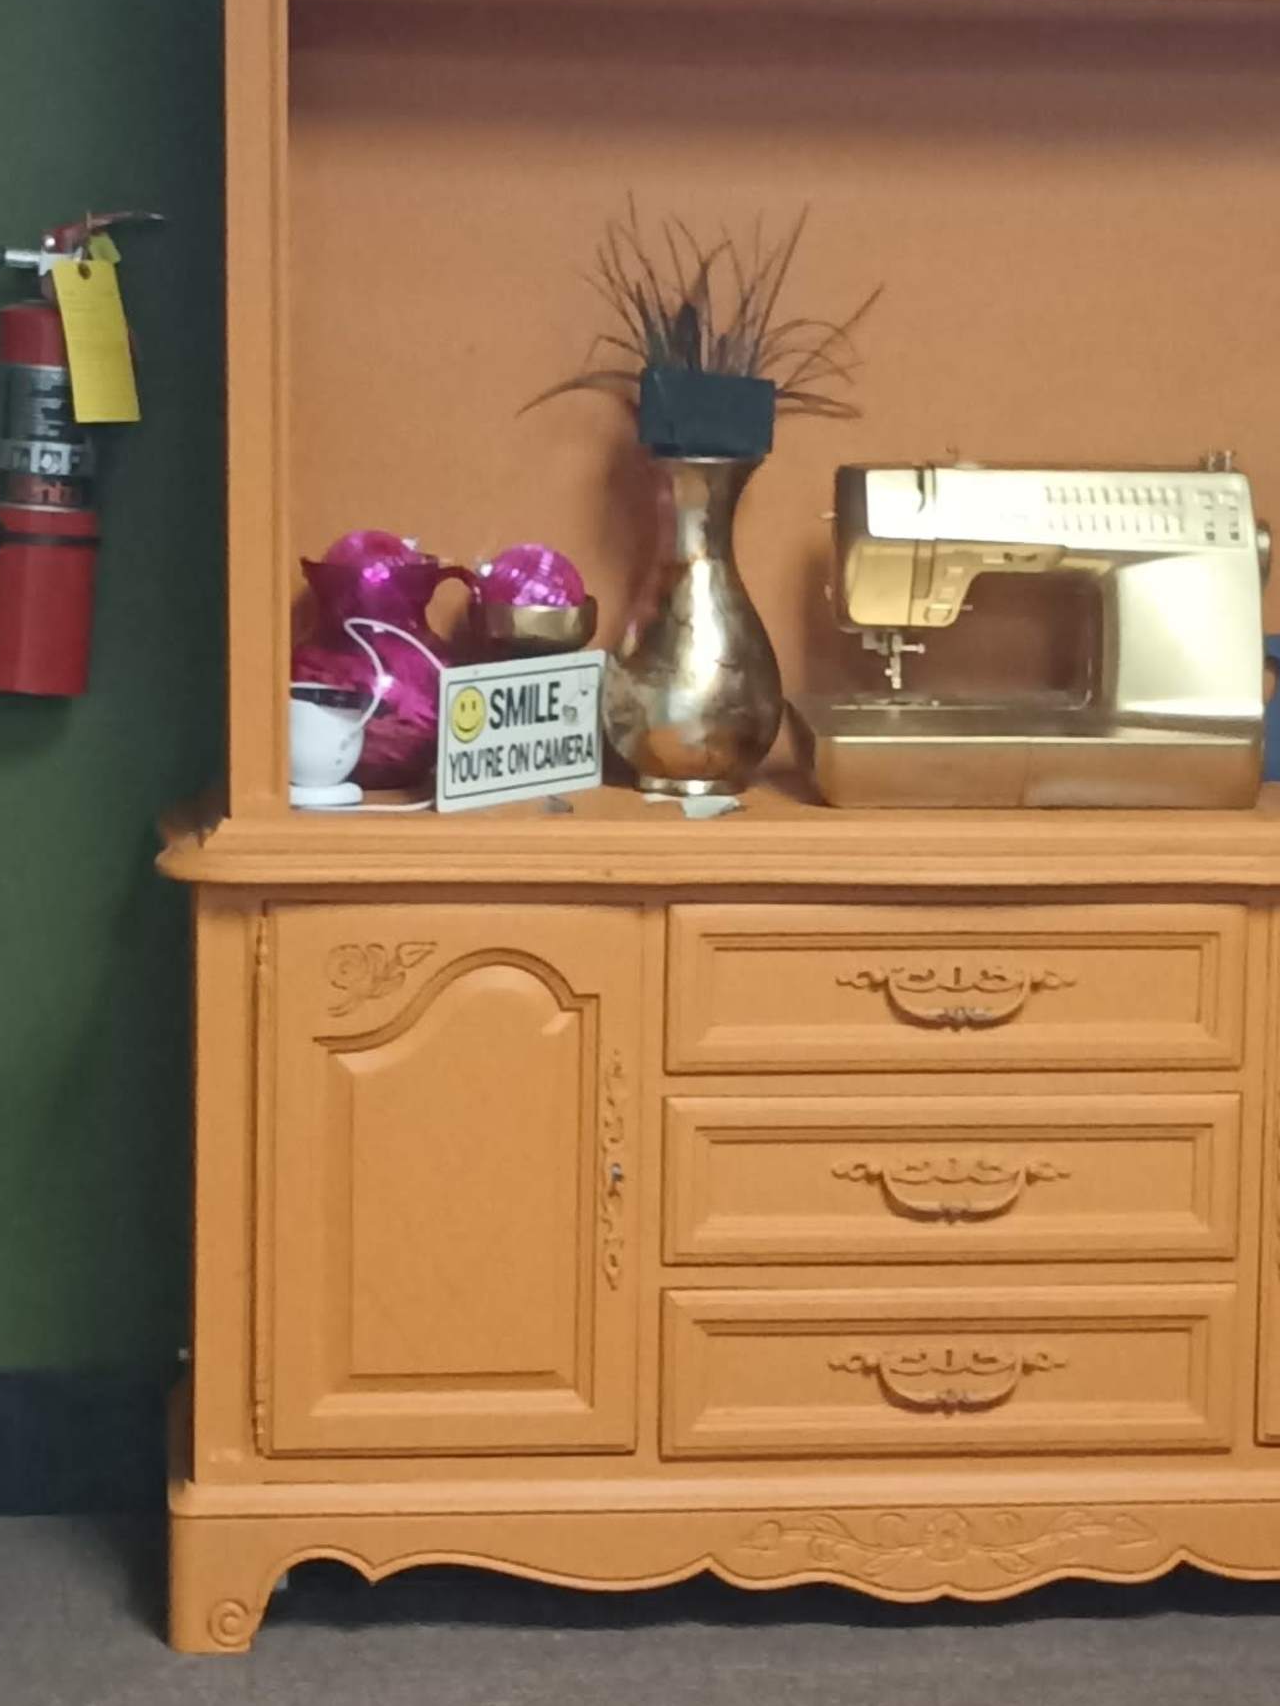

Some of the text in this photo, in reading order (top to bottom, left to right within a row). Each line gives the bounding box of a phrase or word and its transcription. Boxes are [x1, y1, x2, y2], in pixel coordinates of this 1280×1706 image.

[489, 680, 561, 730] SMILE
[448, 733, 595, 784] YOU'RE ON CAMERA
